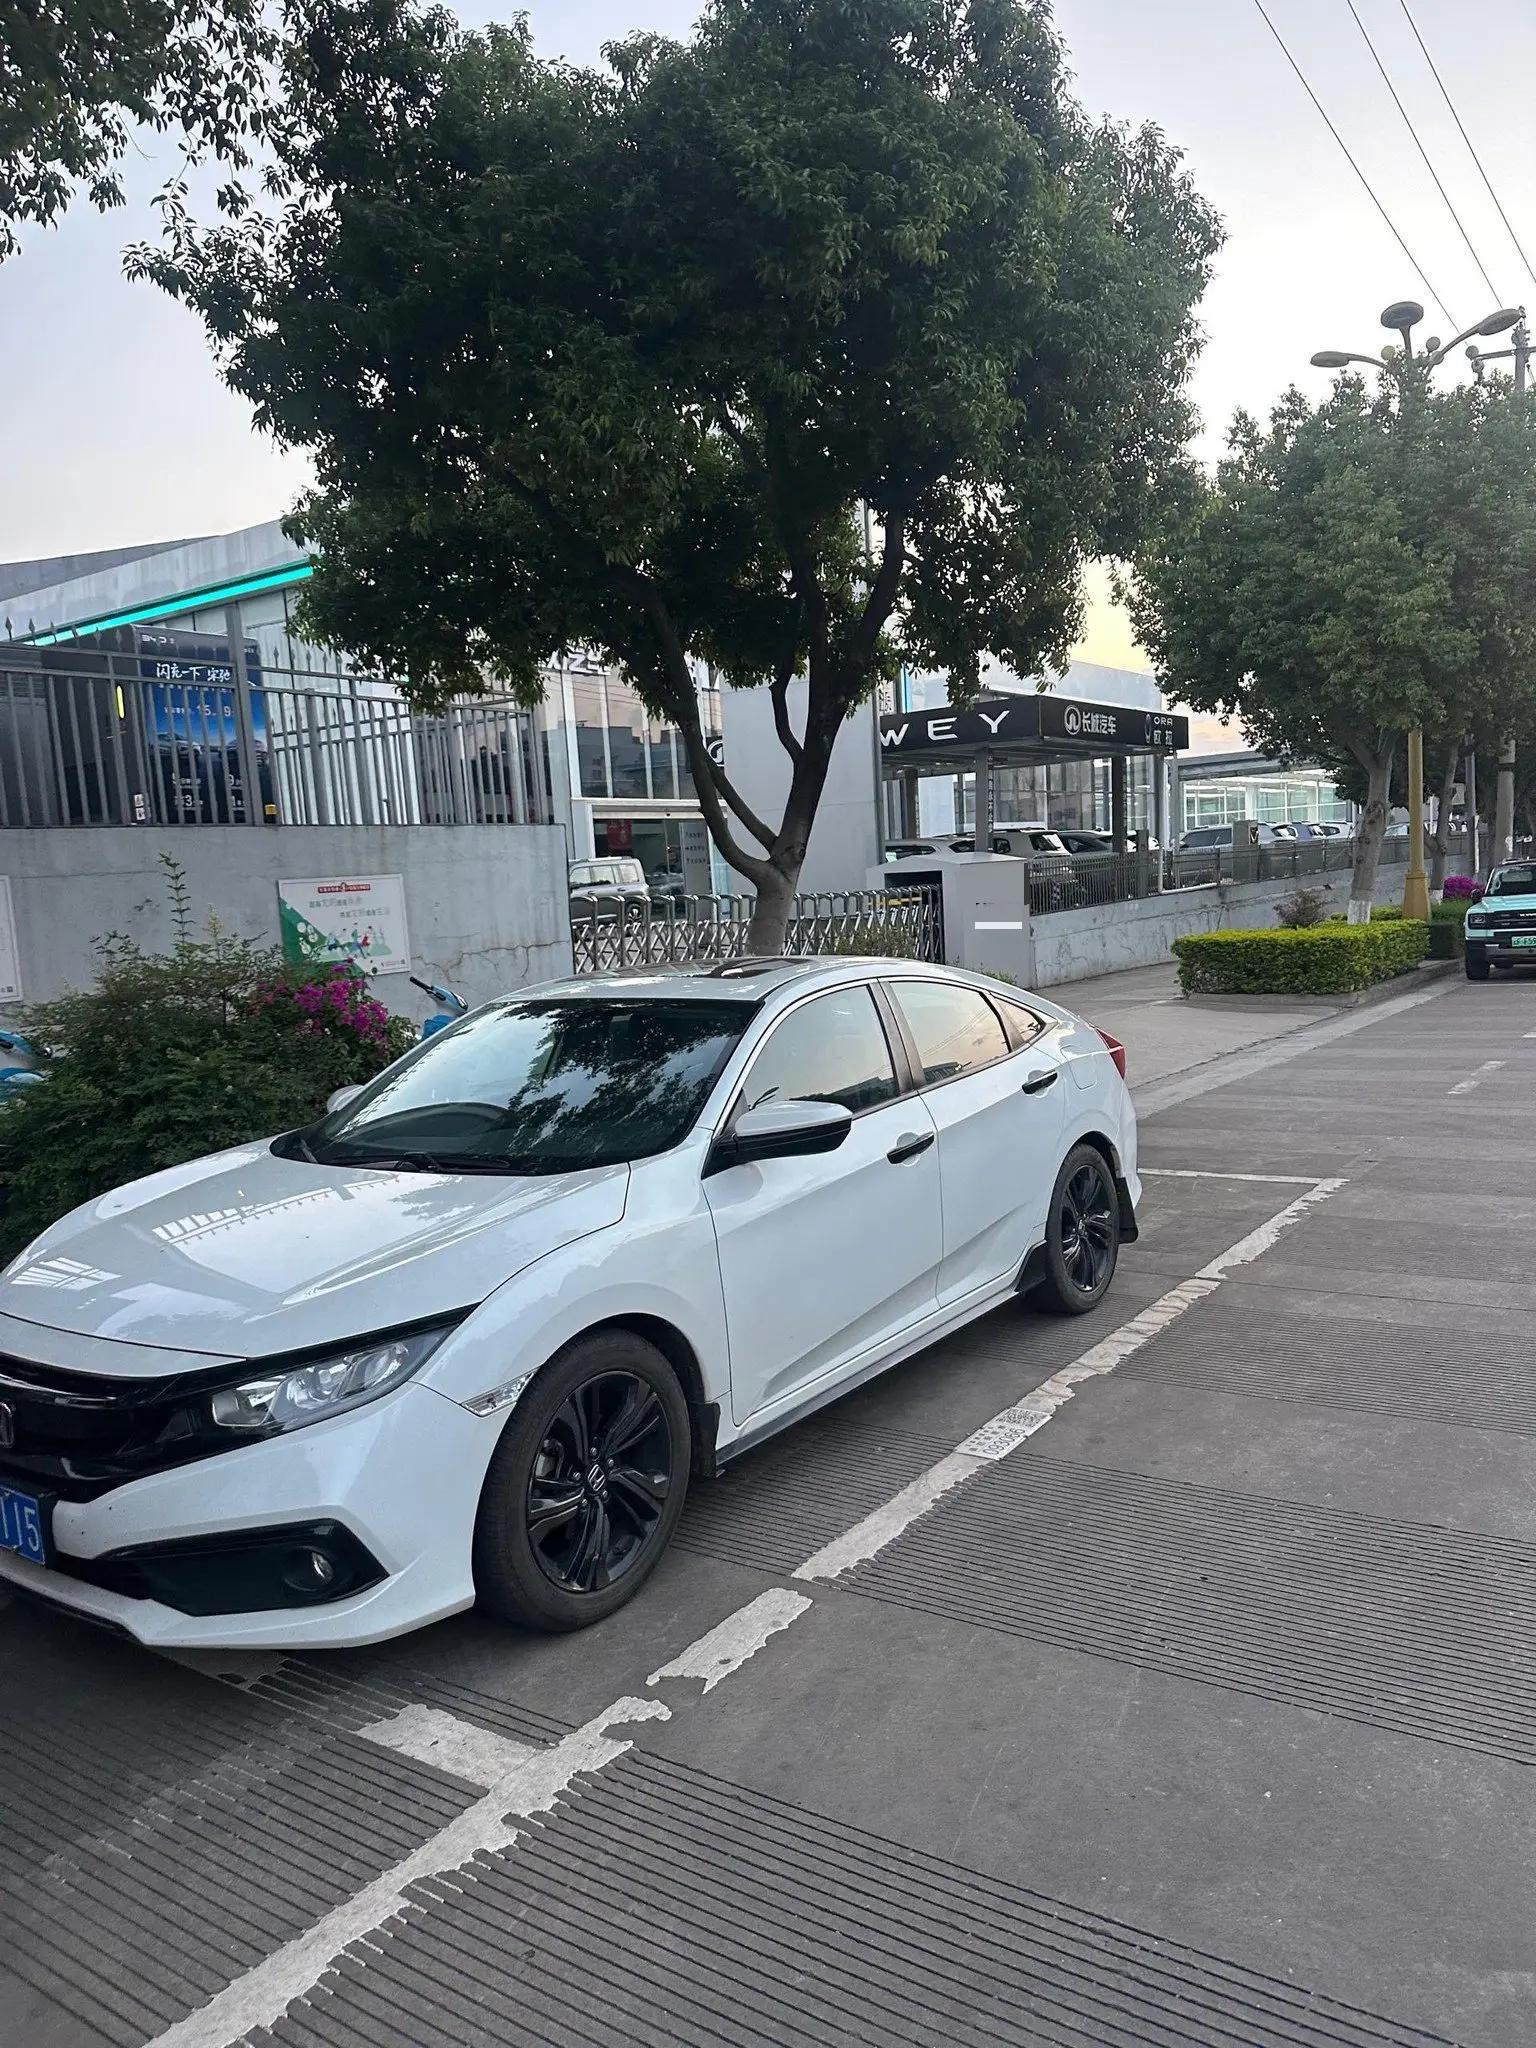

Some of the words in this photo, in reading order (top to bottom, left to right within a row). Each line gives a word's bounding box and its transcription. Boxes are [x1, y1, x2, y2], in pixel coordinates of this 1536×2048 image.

[156, 663, 207, 681] 闪充一下
[880, 710, 1010, 747] WEY
[1082, 712, 1117, 735] 长城汽车
[1153, 716, 1173, 726] ORA
